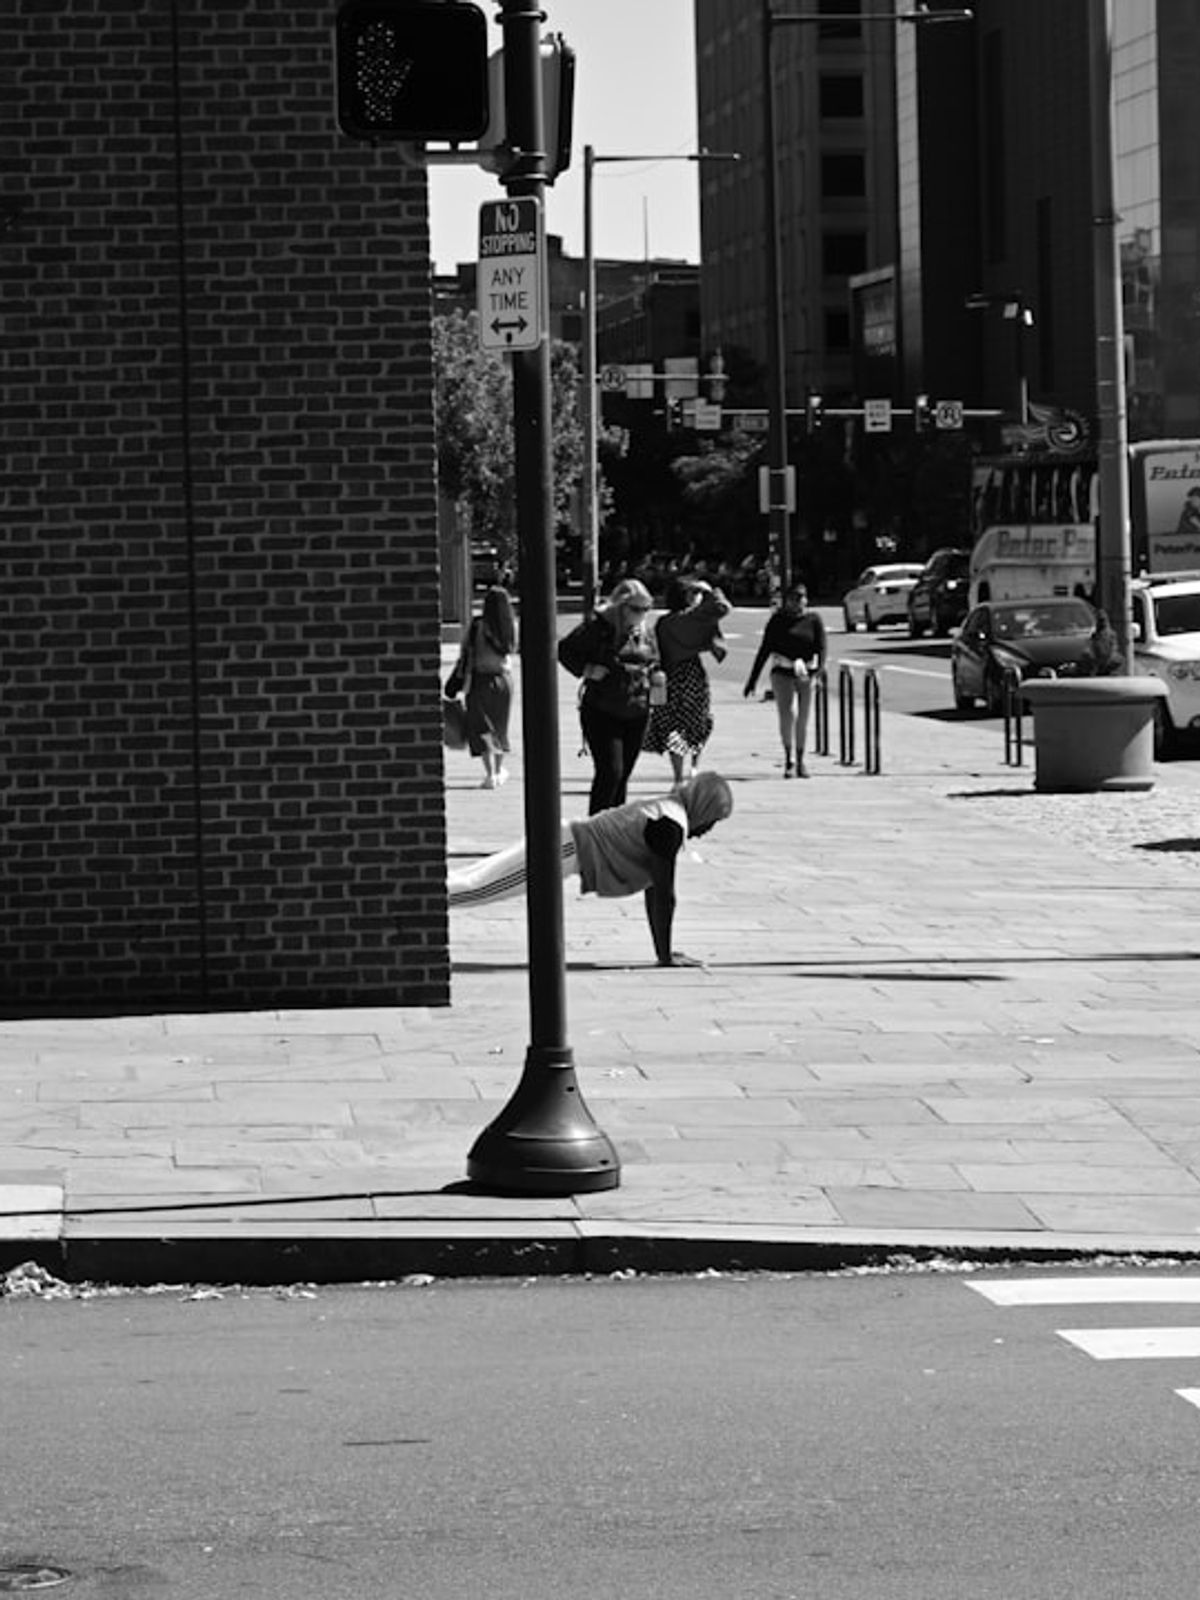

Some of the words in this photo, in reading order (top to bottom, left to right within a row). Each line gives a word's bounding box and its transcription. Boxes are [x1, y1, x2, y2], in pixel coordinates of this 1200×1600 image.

[495, 203, 519, 232] NO
[482, 231, 535, 254] STOPPING
[491, 267, 525, 287] ANY
[489, 291, 529, 311] TIME
